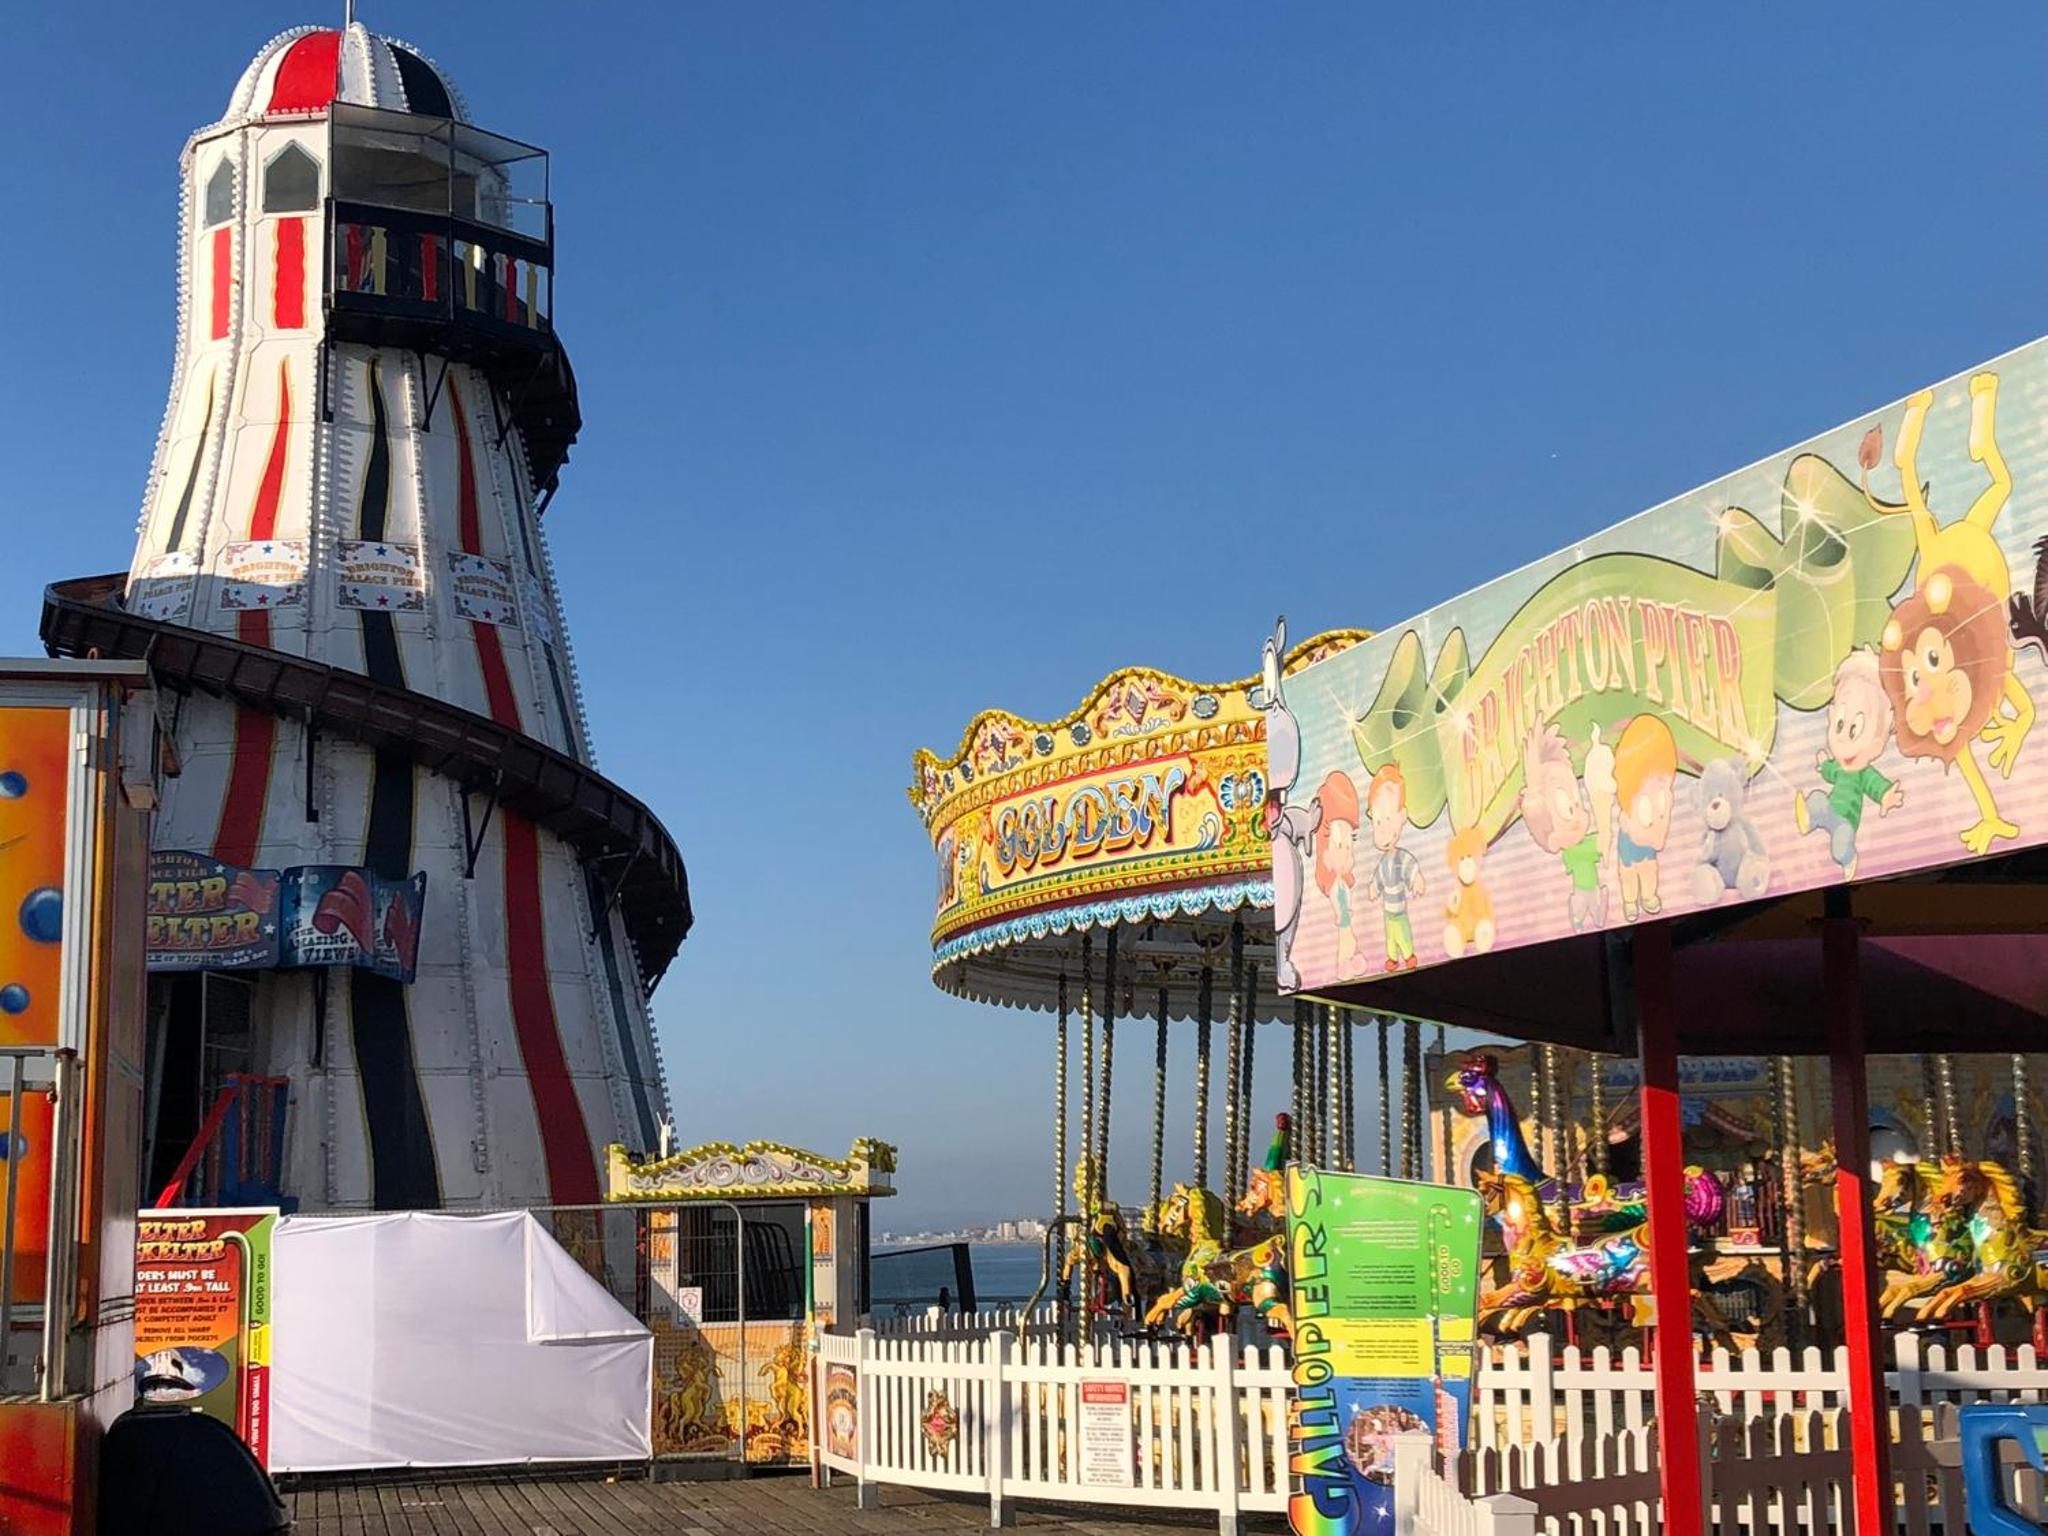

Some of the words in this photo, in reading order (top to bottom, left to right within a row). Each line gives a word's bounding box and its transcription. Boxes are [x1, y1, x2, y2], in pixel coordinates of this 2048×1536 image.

[233, 562, 298, 575] BRIGHTON
[345, 562, 415, 577] BRIGHTON
[341, 573, 388, 585] PALACE
[392, 576, 422, 587] PIER
[1461, 595, 1638, 830] BRIGHTON
[1636, 597, 1755, 757] PIER
[996, 765, 1187, 876] GOLDEN
[148, 877, 227, 914] TER
[147, 911, 260, 949] ELTER
[138, 1219, 207, 1242] ELTER
[137, 1240, 226, 1262] KELTER
[137, 1270, 166, 1281] DERS
[168, 1269, 200, 1280] MUST
[201, 1269, 216, 1280] BE
[255, 1272, 265, 1284] TO
[148, 1281, 180, 1293] LEAST
[205, 1281, 231, 1292] TALL
[255, 1286, 265, 1315] GOOD
[161, 1305, 216, 1314] ACCOMPANIED
[144, 1315, 190, 1323] COMPETENT
[193, 1314, 217, 1323] ADULT
[188, 1334, 218, 1342] POCKETS
[1287, 1163, 1360, 1536] GALLOPERS
[251, 1400, 260, 1416] TOO
